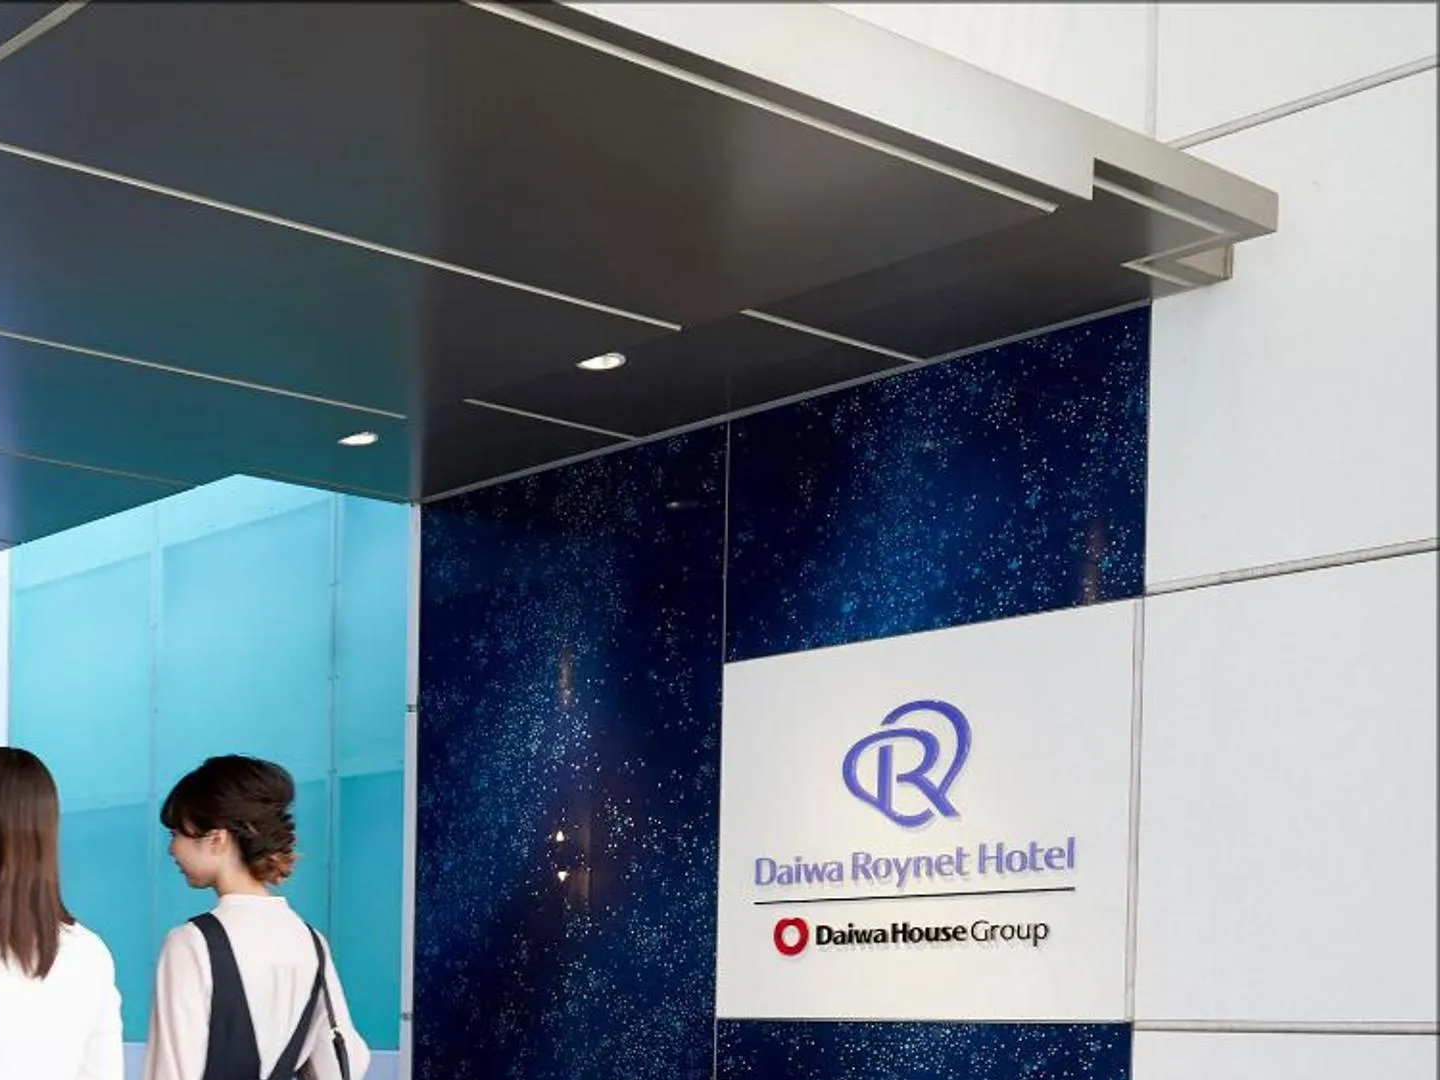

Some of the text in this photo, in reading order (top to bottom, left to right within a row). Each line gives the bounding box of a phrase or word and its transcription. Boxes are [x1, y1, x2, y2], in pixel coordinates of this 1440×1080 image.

[754, 836, 1076, 888] Daiwa Roynet Hotel
[971, 920, 1050, 947] Group
